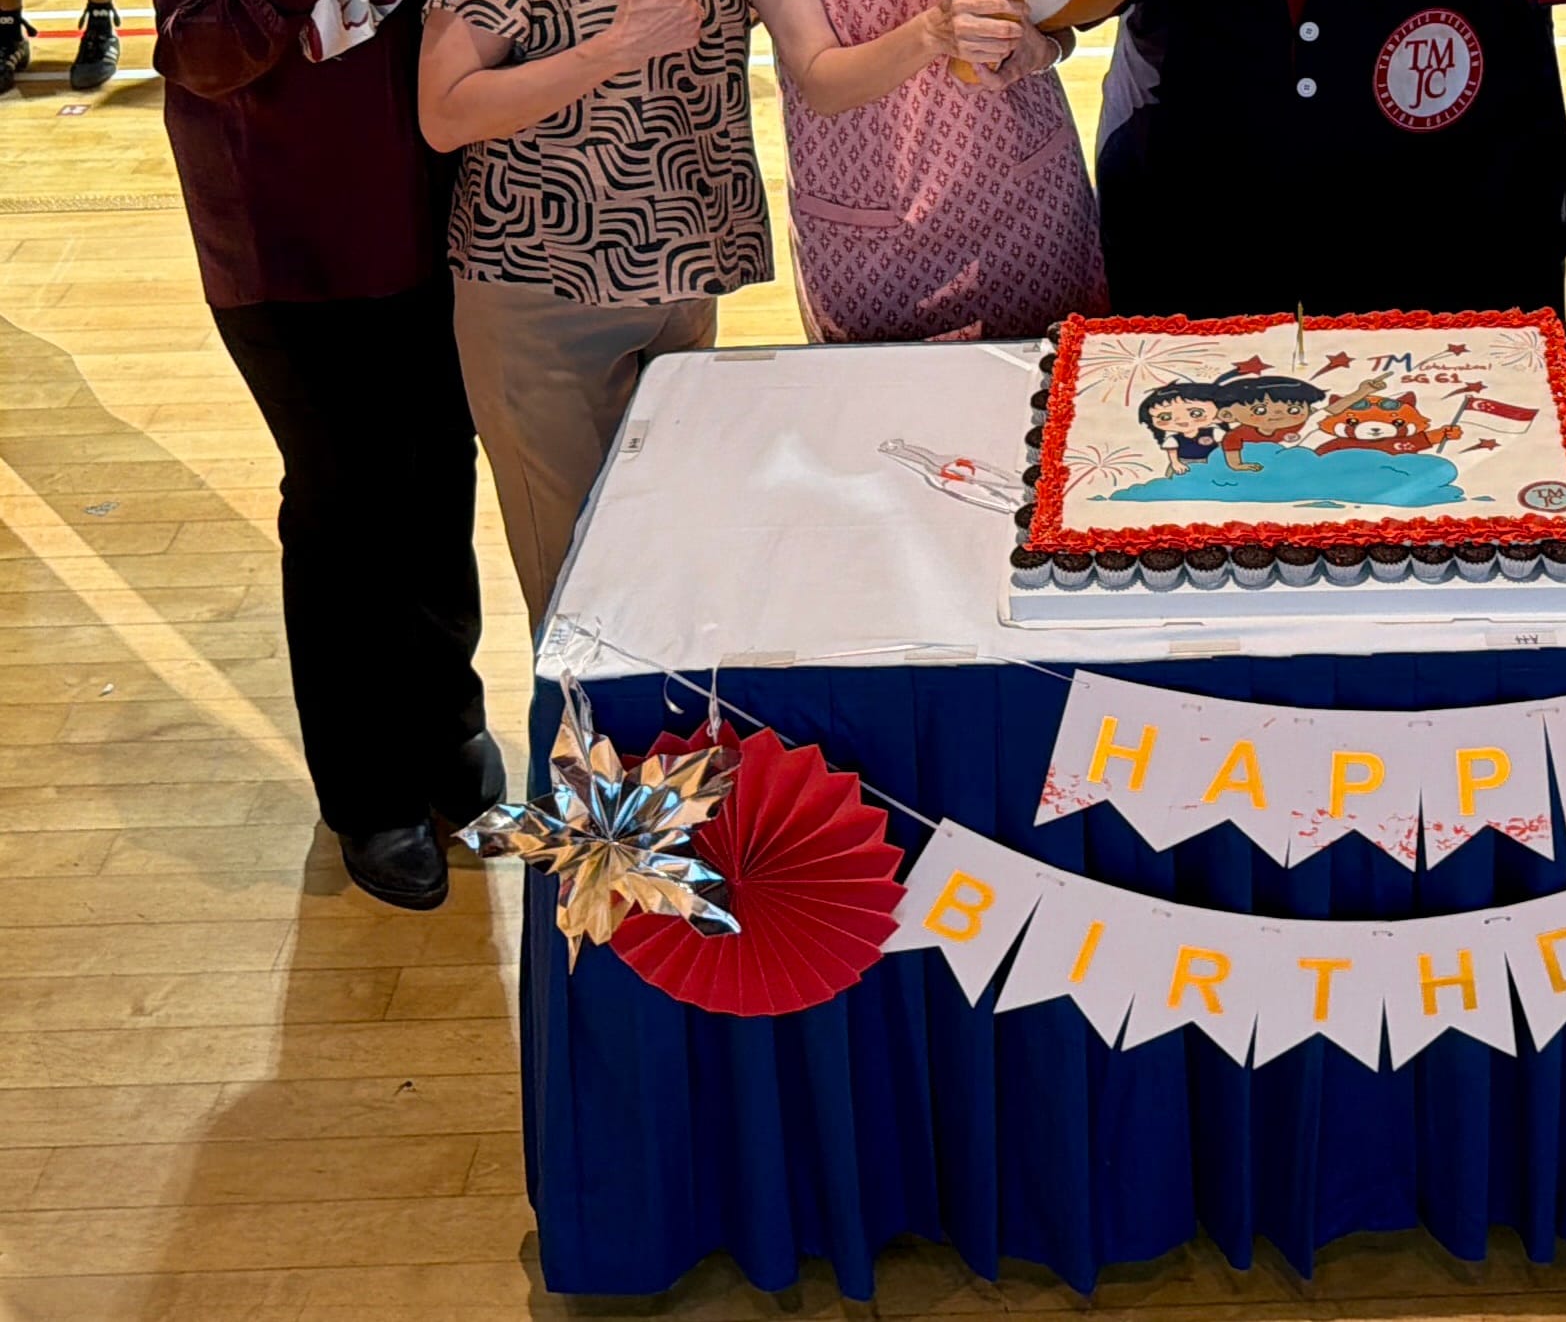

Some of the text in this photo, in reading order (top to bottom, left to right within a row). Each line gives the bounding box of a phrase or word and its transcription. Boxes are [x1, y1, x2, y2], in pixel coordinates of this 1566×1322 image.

[1404, 37, 1455, 71] TM
[1408, 68, 1447, 109] JC
[1366, 352, 1412, 372] TM
[1400, 373, 1463, 384] SG 61
[1531, 487, 1566, 499] TM
